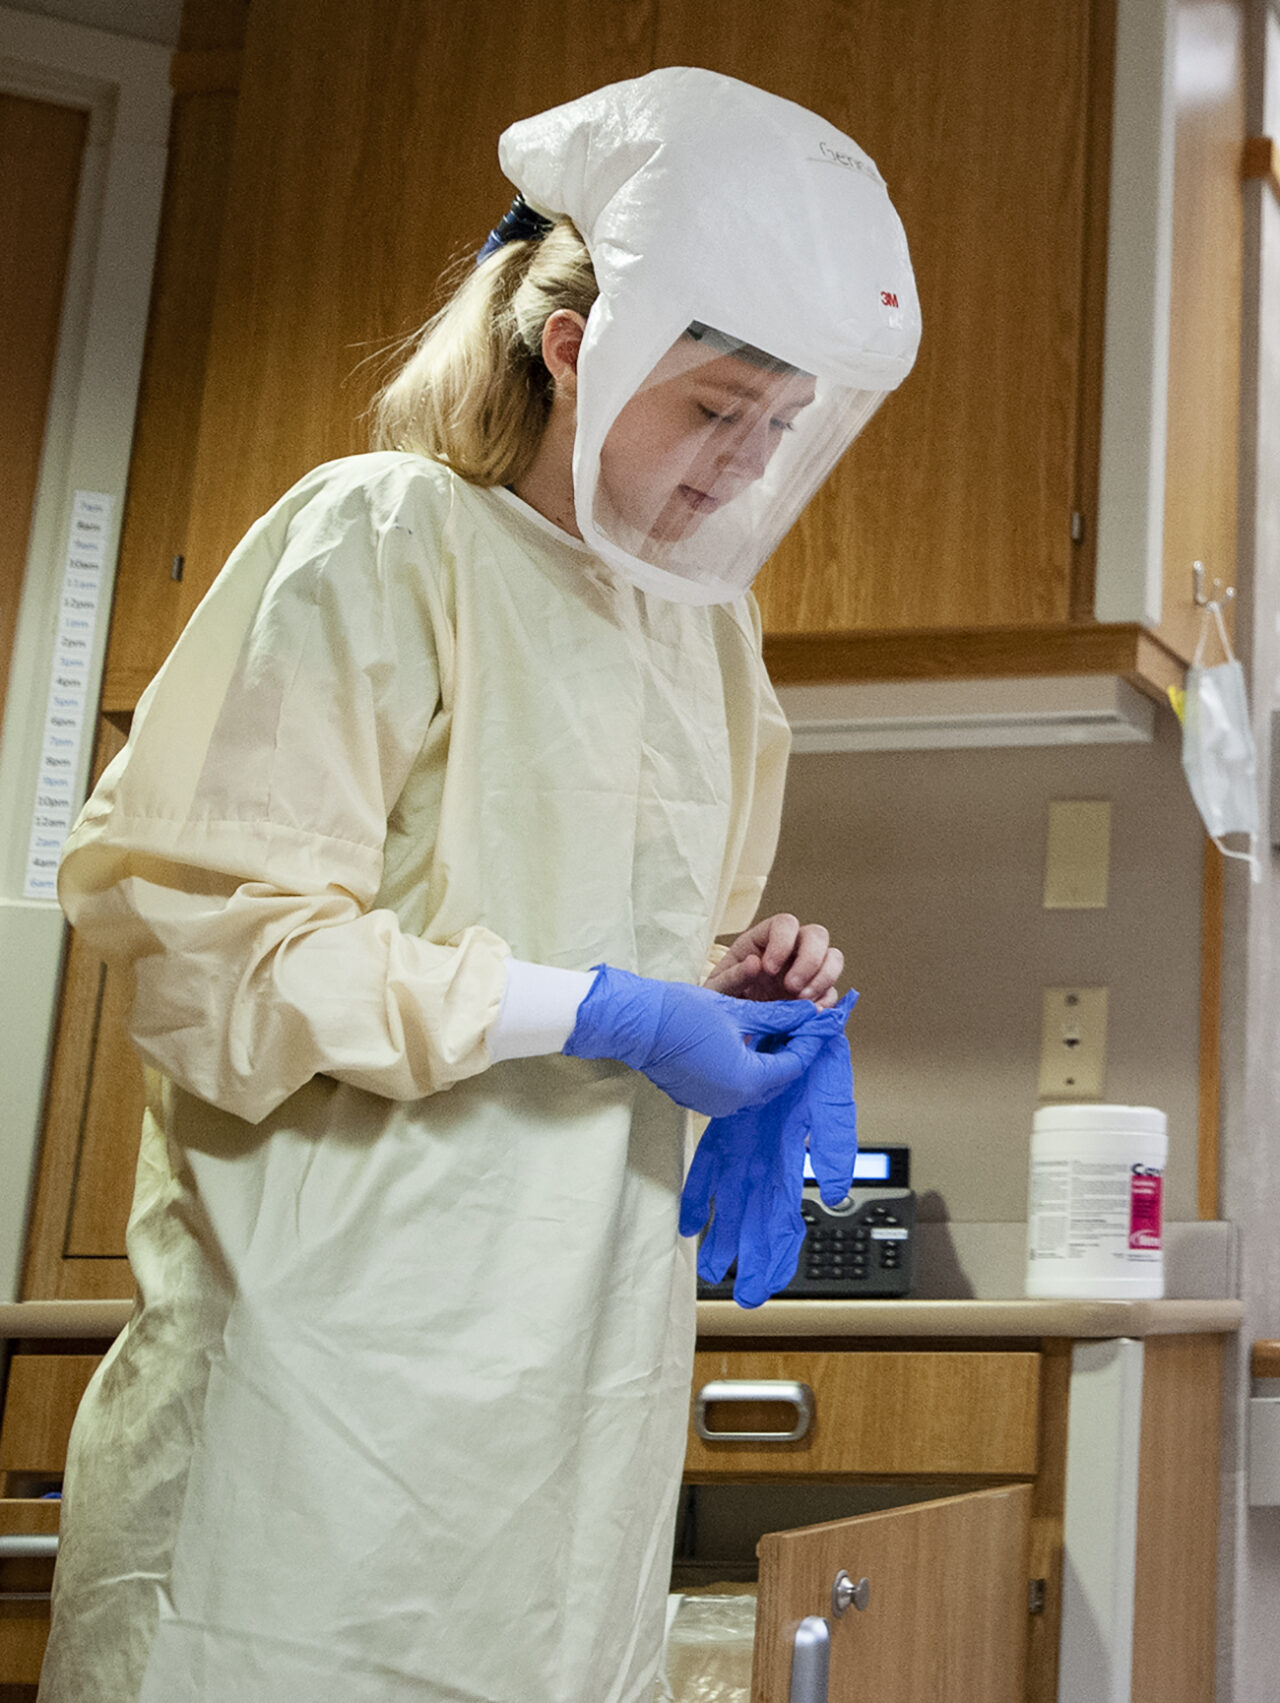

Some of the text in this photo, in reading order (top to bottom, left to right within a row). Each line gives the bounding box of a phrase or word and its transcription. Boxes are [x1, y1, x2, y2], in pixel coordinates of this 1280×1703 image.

[880, 290, 899, 309] 3M
[69, 558, 99, 570] 10am
[64, 597, 95, 609] 12pm
[61, 636, 86, 648] 2pm
[57, 676, 81, 687] 4pm
[50, 716, 76, 727] 6pm
[45, 756, 71, 767] 8pm
